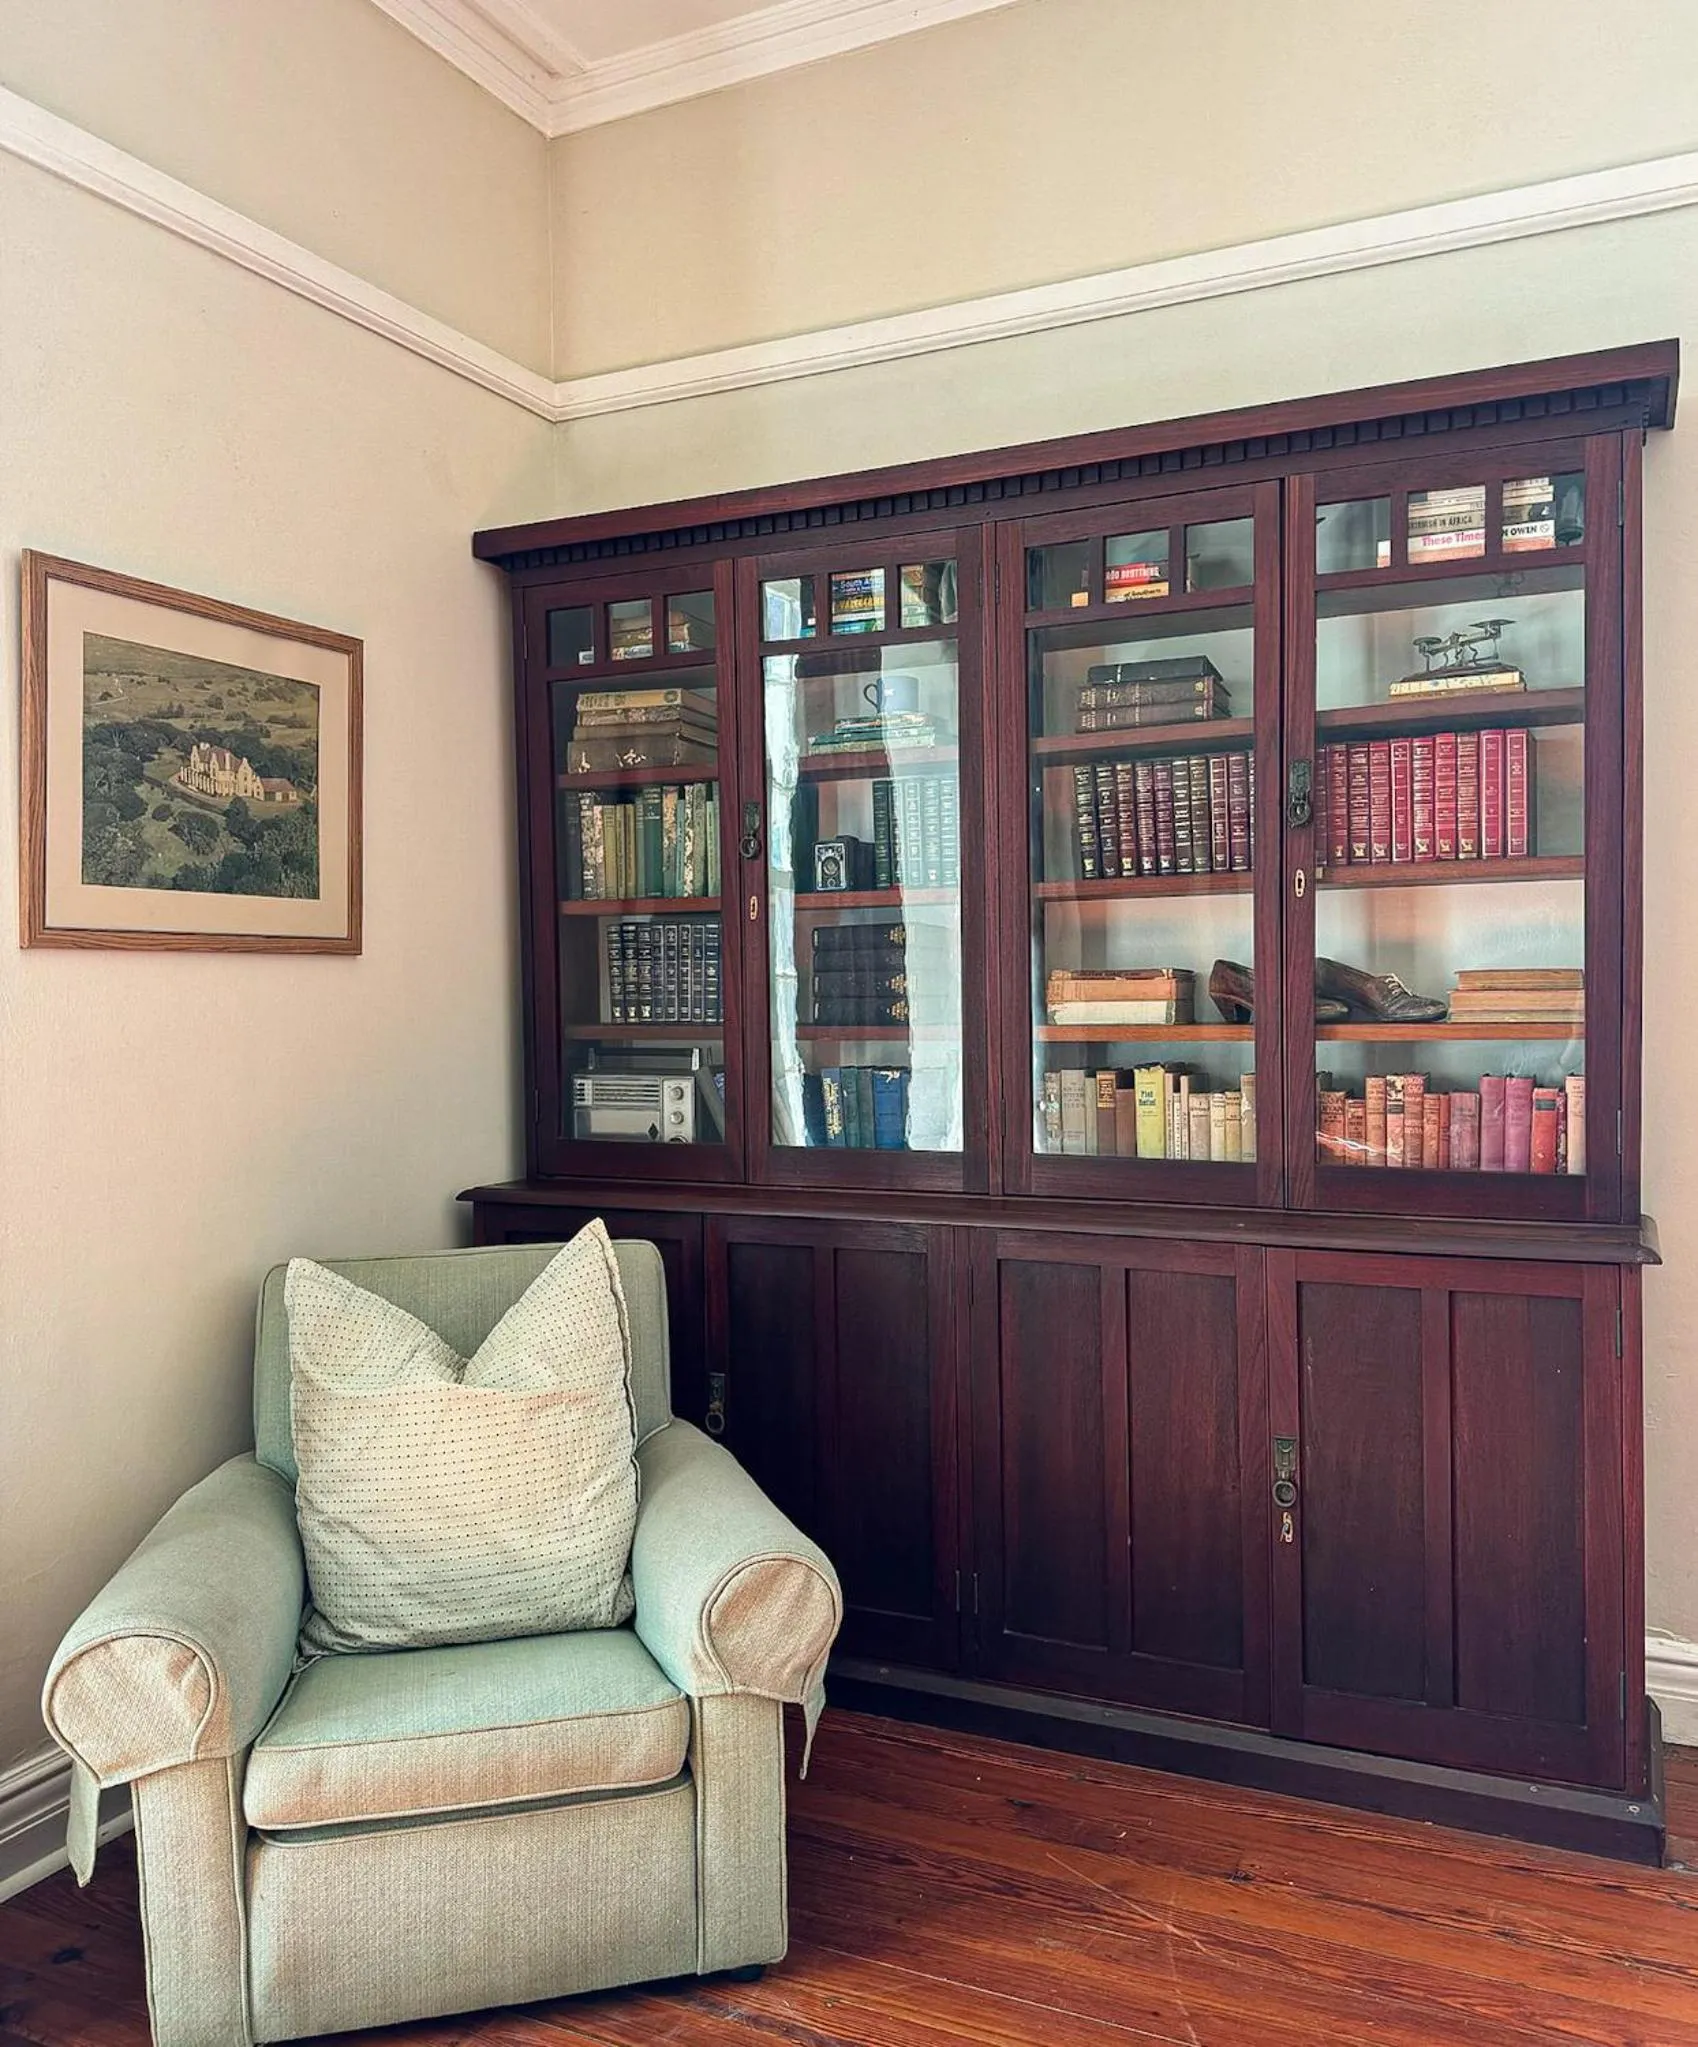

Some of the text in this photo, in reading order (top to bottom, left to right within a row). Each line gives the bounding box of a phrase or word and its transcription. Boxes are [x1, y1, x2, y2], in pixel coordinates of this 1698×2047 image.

[1448, 515, 1473, 527] AFRICA
[1510, 524, 1538, 536] OWEN
[1421, 535, 1453, 547] These
